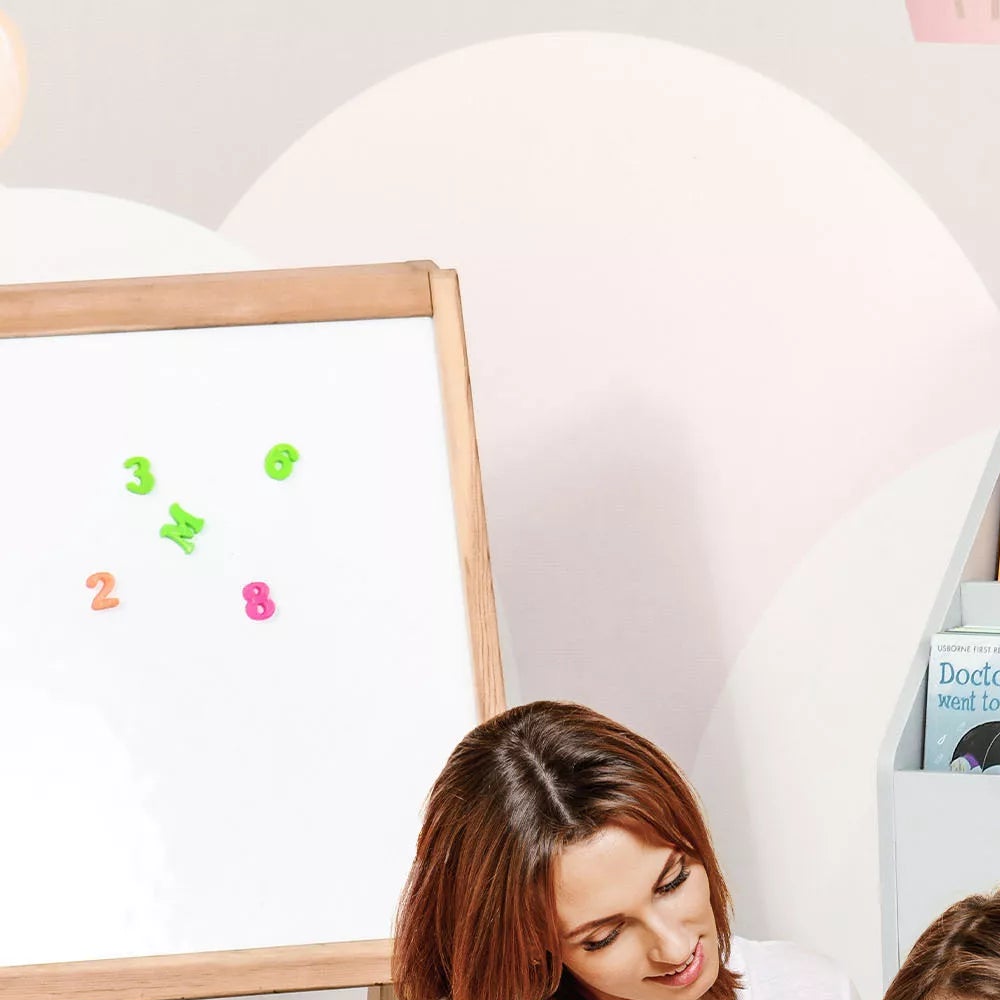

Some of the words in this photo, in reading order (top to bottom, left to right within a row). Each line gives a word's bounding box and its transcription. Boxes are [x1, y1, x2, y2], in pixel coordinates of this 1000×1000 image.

[123, 456, 156, 495] 3
[264, 442, 300, 481] 6
[86, 571, 120, 611] 2
[242, 581, 276, 621] 8
[937, 645, 971, 653] USBORNE
[973, 645, 992, 654] FIRST
[937, 690, 976, 711] went
[982, 690, 1000, 711] to
